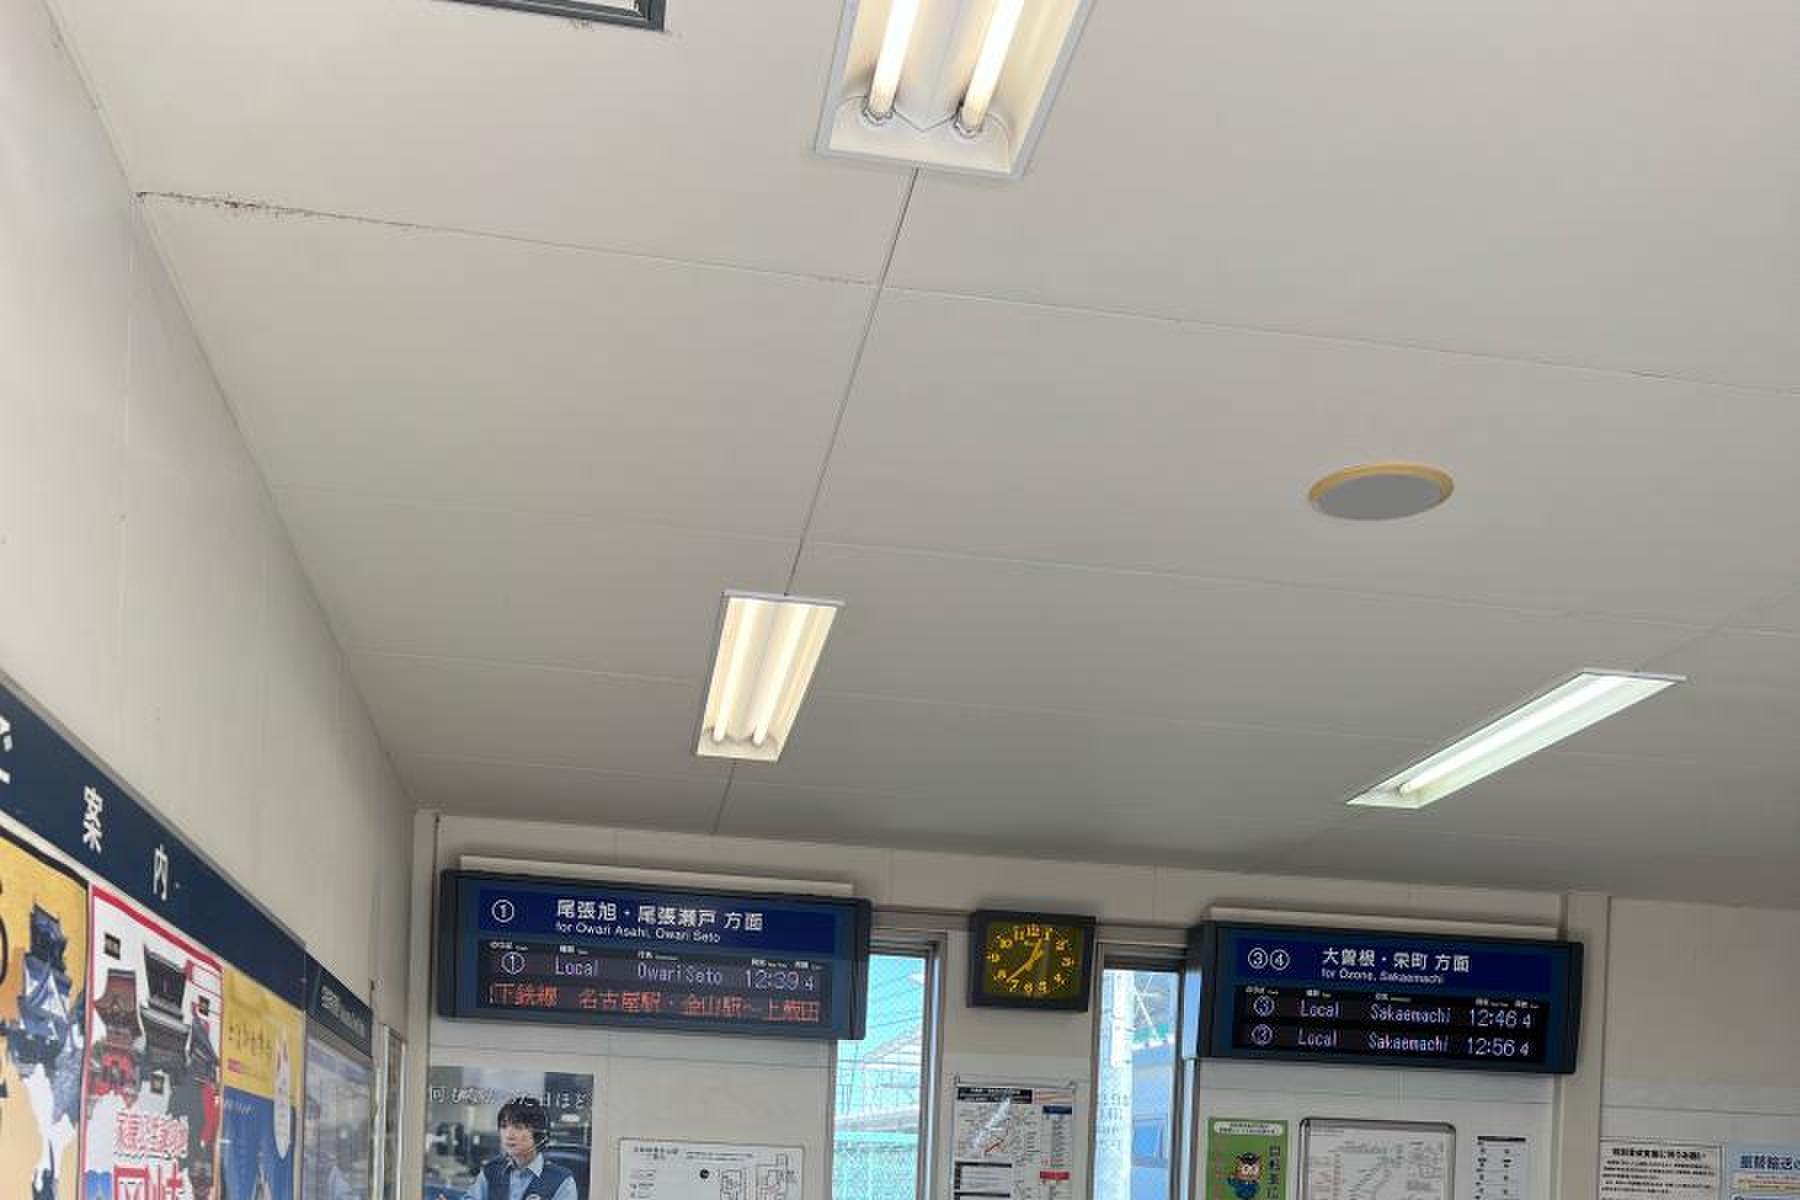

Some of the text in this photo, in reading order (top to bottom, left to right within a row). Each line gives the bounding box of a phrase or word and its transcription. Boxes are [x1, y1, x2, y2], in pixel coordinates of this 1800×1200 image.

[724, 911, 763, 931] 方面
[555, 954, 599, 977] Local
[1435, 954, 1470, 973] 方面
[686, 965, 722, 986] Seto
[746, 969, 799, 991] 12:39
[1301, 1000, 1339, 1017] Local
[1371, 1003, 1451, 1024] Sakaemachi
[1470, 1008, 1517, 1028] 12:46
[1298, 1028, 1337, 1046] Local
[1368, 1031, 1449, 1052] Sakaemachi
[1467, 1037, 1515, 1056] 12:56
